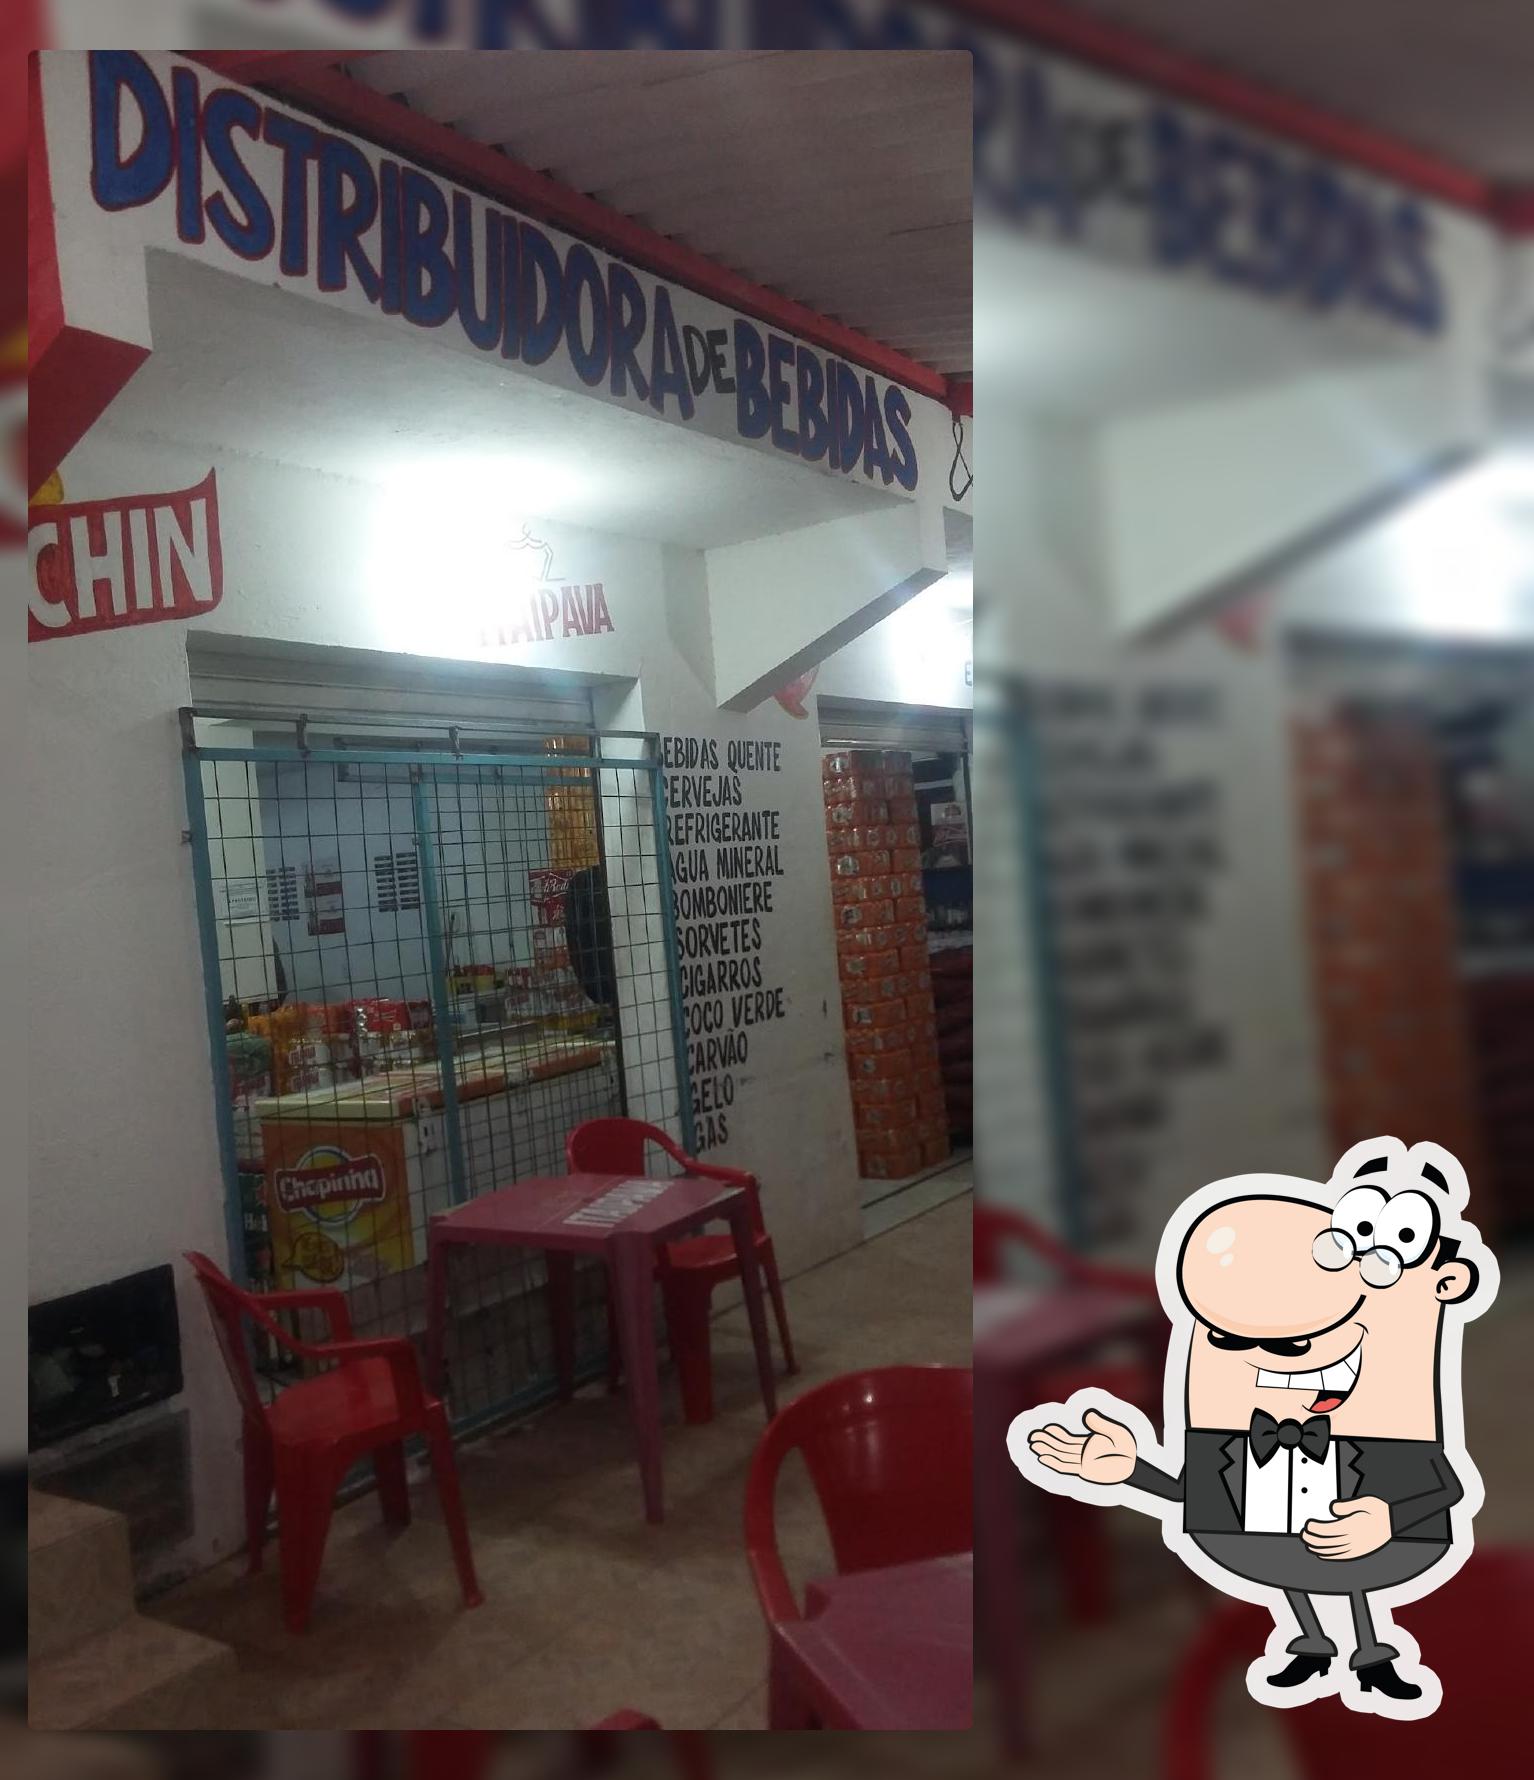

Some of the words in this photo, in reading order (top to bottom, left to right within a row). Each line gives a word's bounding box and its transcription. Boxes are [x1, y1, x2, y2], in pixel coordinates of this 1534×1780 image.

[88, 50, 694, 421] DISTRIBUIDORA
[682, 324, 736, 397] DE
[734, 318, 919, 492] BEBIDAS
[28, 497, 214, 628] CHIN
[660, 737, 719, 770] EBIDAS
[727, 740, 782, 773] QUENTE
[716, 844, 785, 880] MINERAL
[676, 917, 762, 960] SORVETES
[681, 955, 763, 1000] CIGARROS
[732, 987, 785, 1029] VERDE
[695, 1112, 729, 1154] GAS
